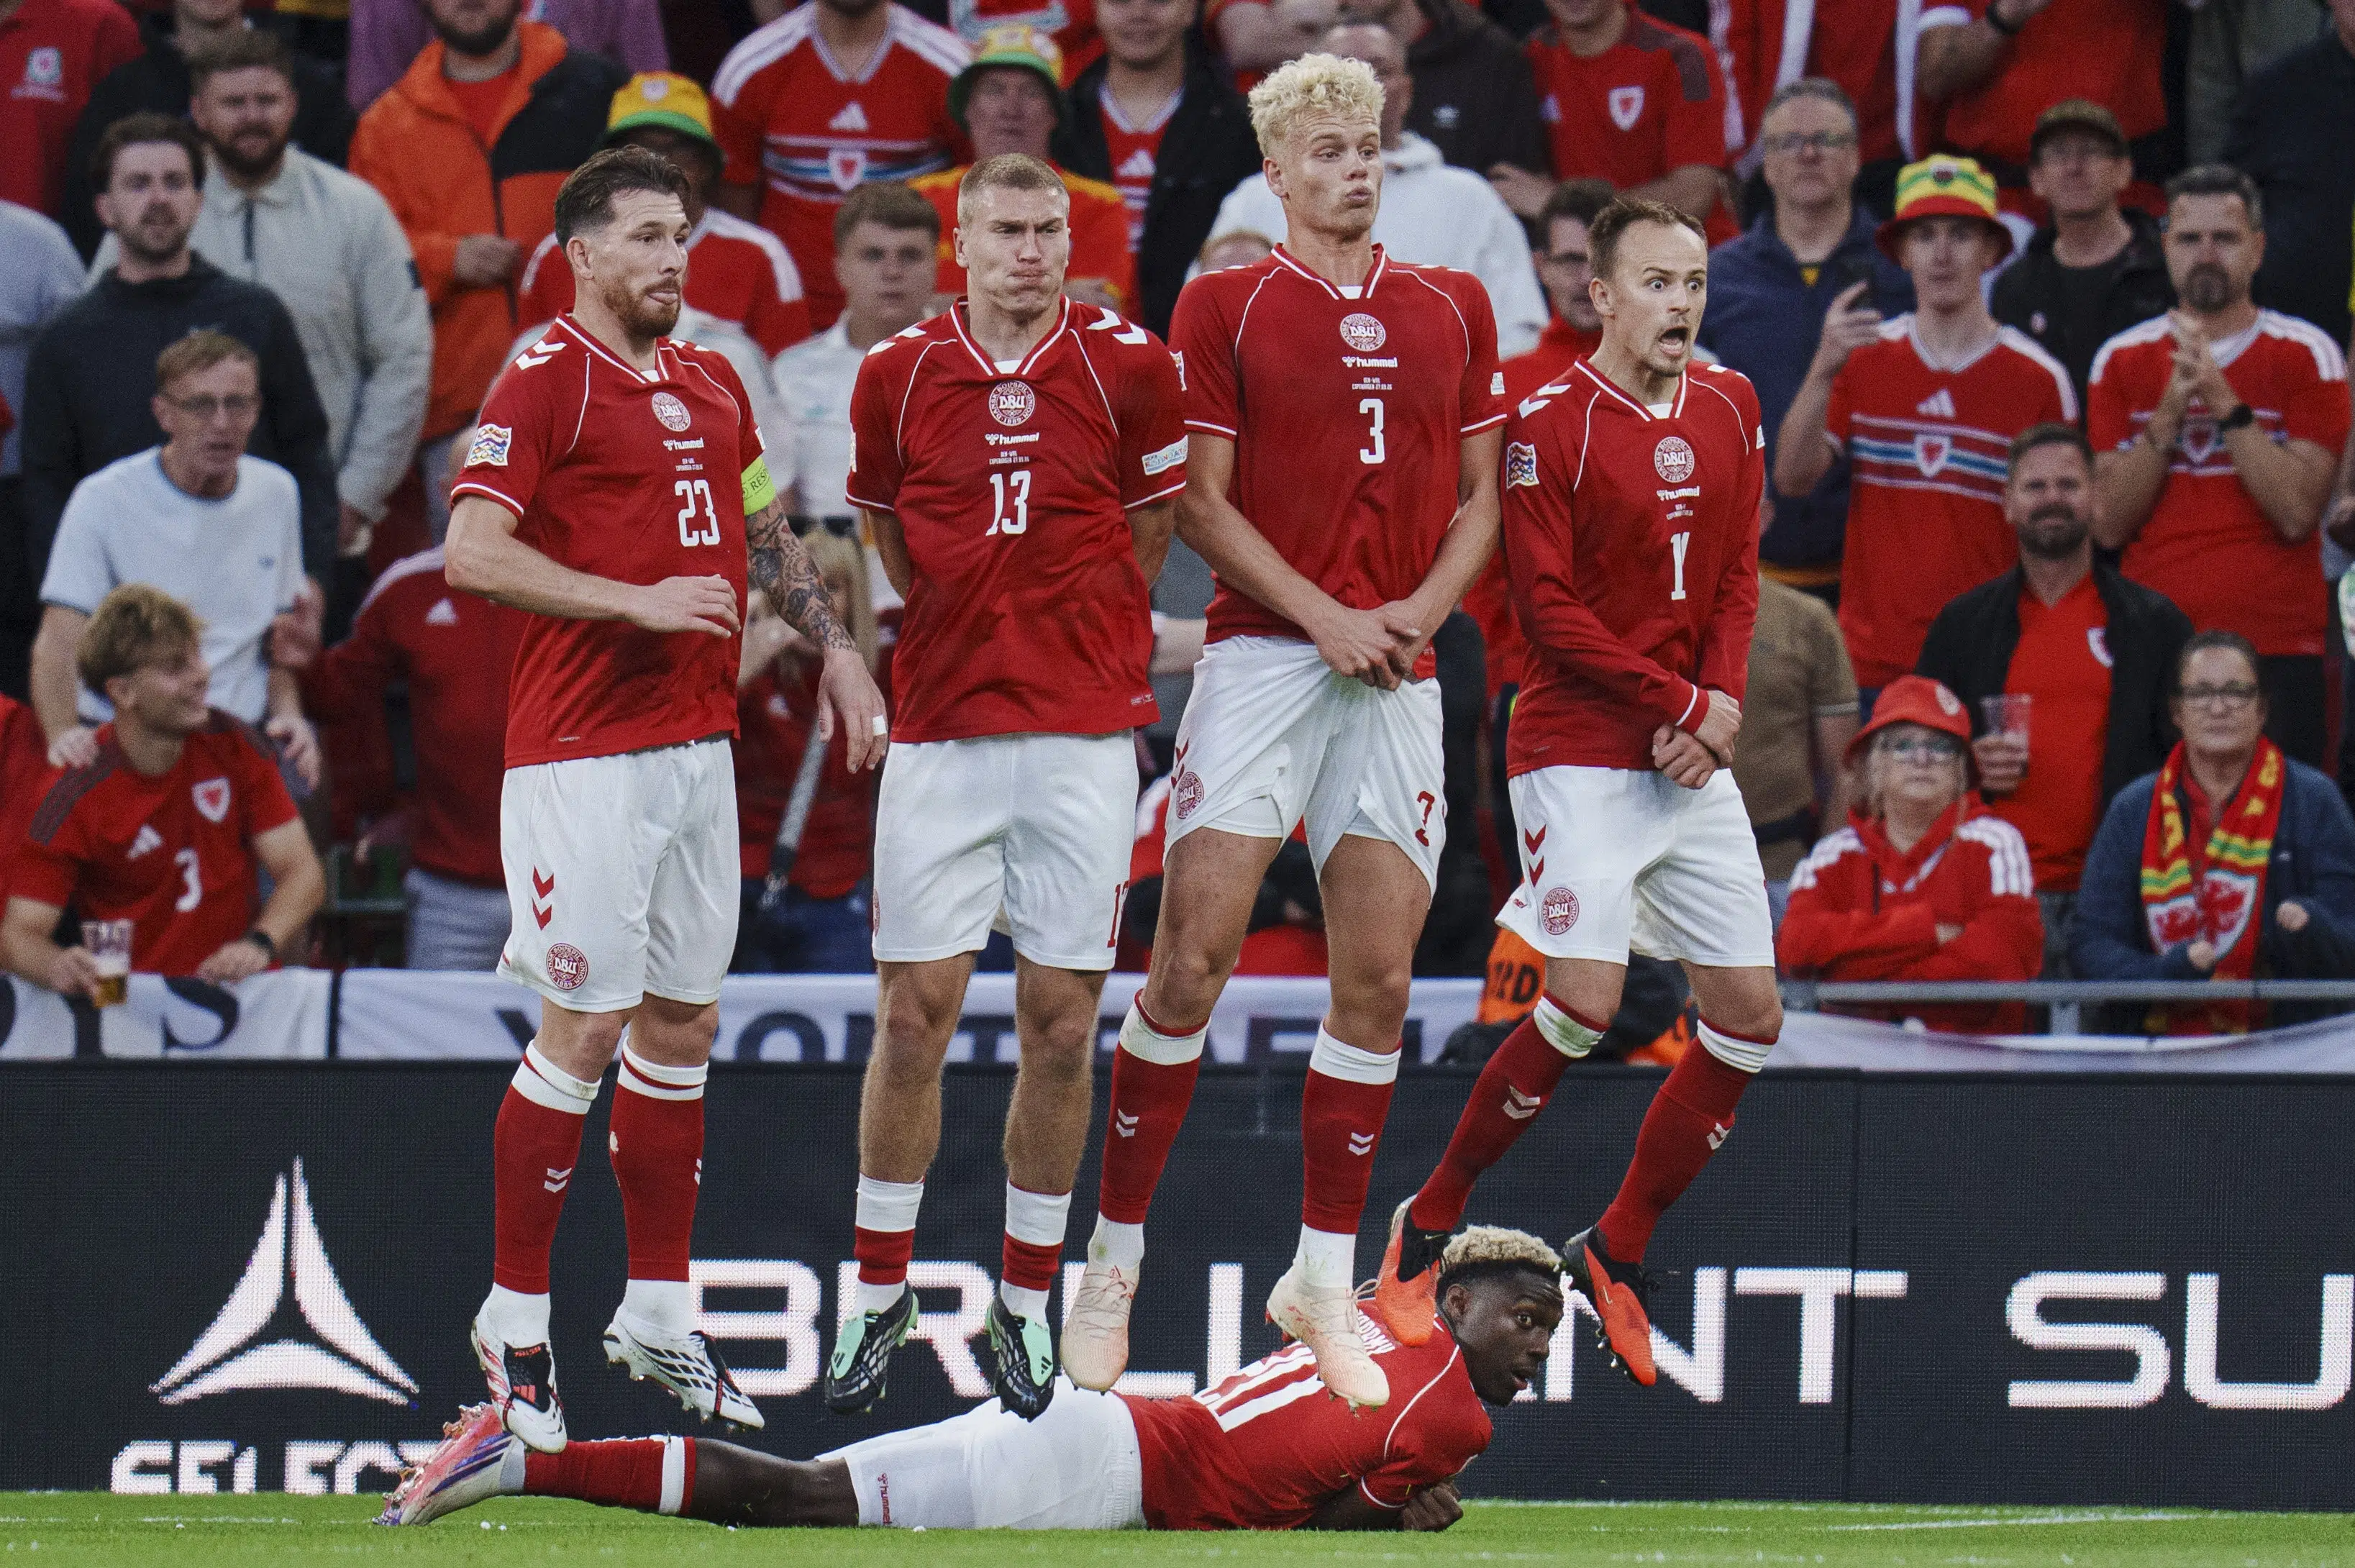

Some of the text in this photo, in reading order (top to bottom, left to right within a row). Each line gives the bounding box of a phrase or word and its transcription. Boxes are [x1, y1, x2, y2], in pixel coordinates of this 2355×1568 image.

[1349, 326, 1376, 337] DBU
[1357, 357, 1398, 368] hummel
[999, 395, 1025, 409] DBU
[999, 432, 1040, 445] hummel
[1359, 398, 1385, 464] 3
[674, 437, 704, 450] hummel
[1663, 452, 1686, 466] DBU
[985, 470, 1031, 536] 13
[675, 478, 721, 547] 23
[175, 848, 203, 913] 3
[1548, 902, 1569, 919] DBU
[555, 957, 577, 975] DBU
